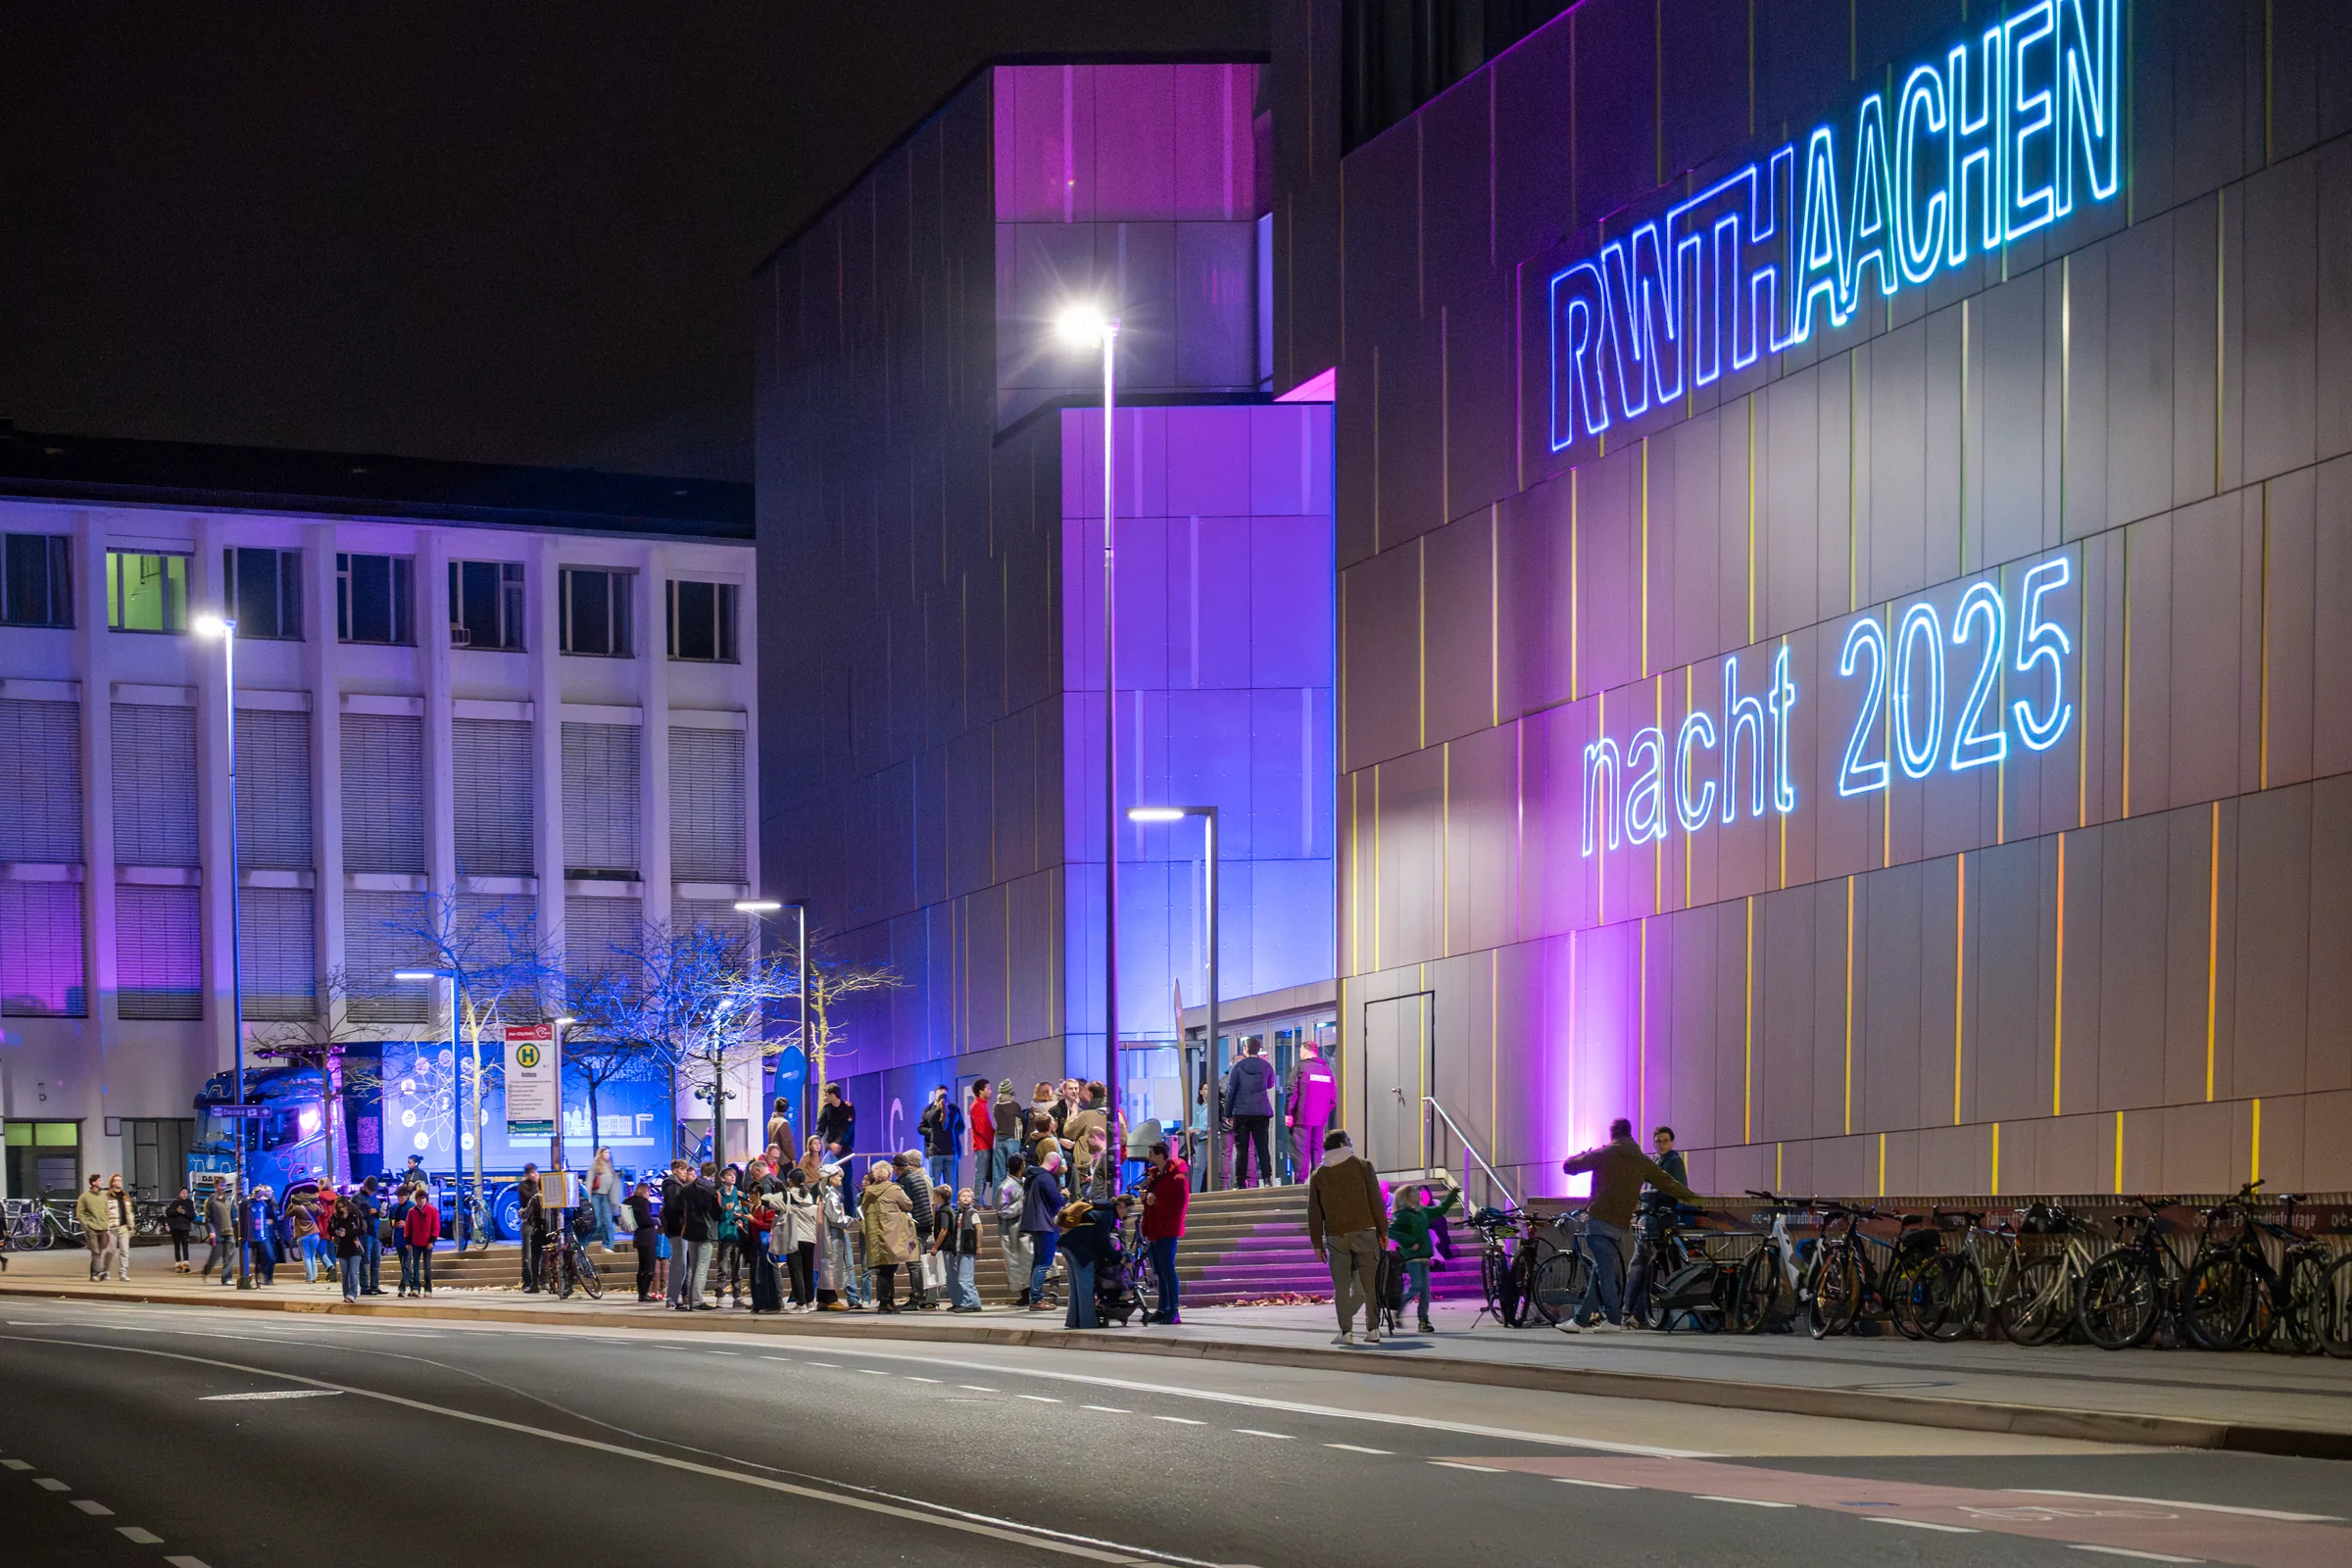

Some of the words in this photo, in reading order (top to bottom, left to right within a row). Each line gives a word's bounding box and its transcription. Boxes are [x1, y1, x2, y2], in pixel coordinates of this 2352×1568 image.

[1581, 645, 1796, 858] nacht
[1838, 556, 2072, 797] 2025
[521, 1049, 535, 1063] H
